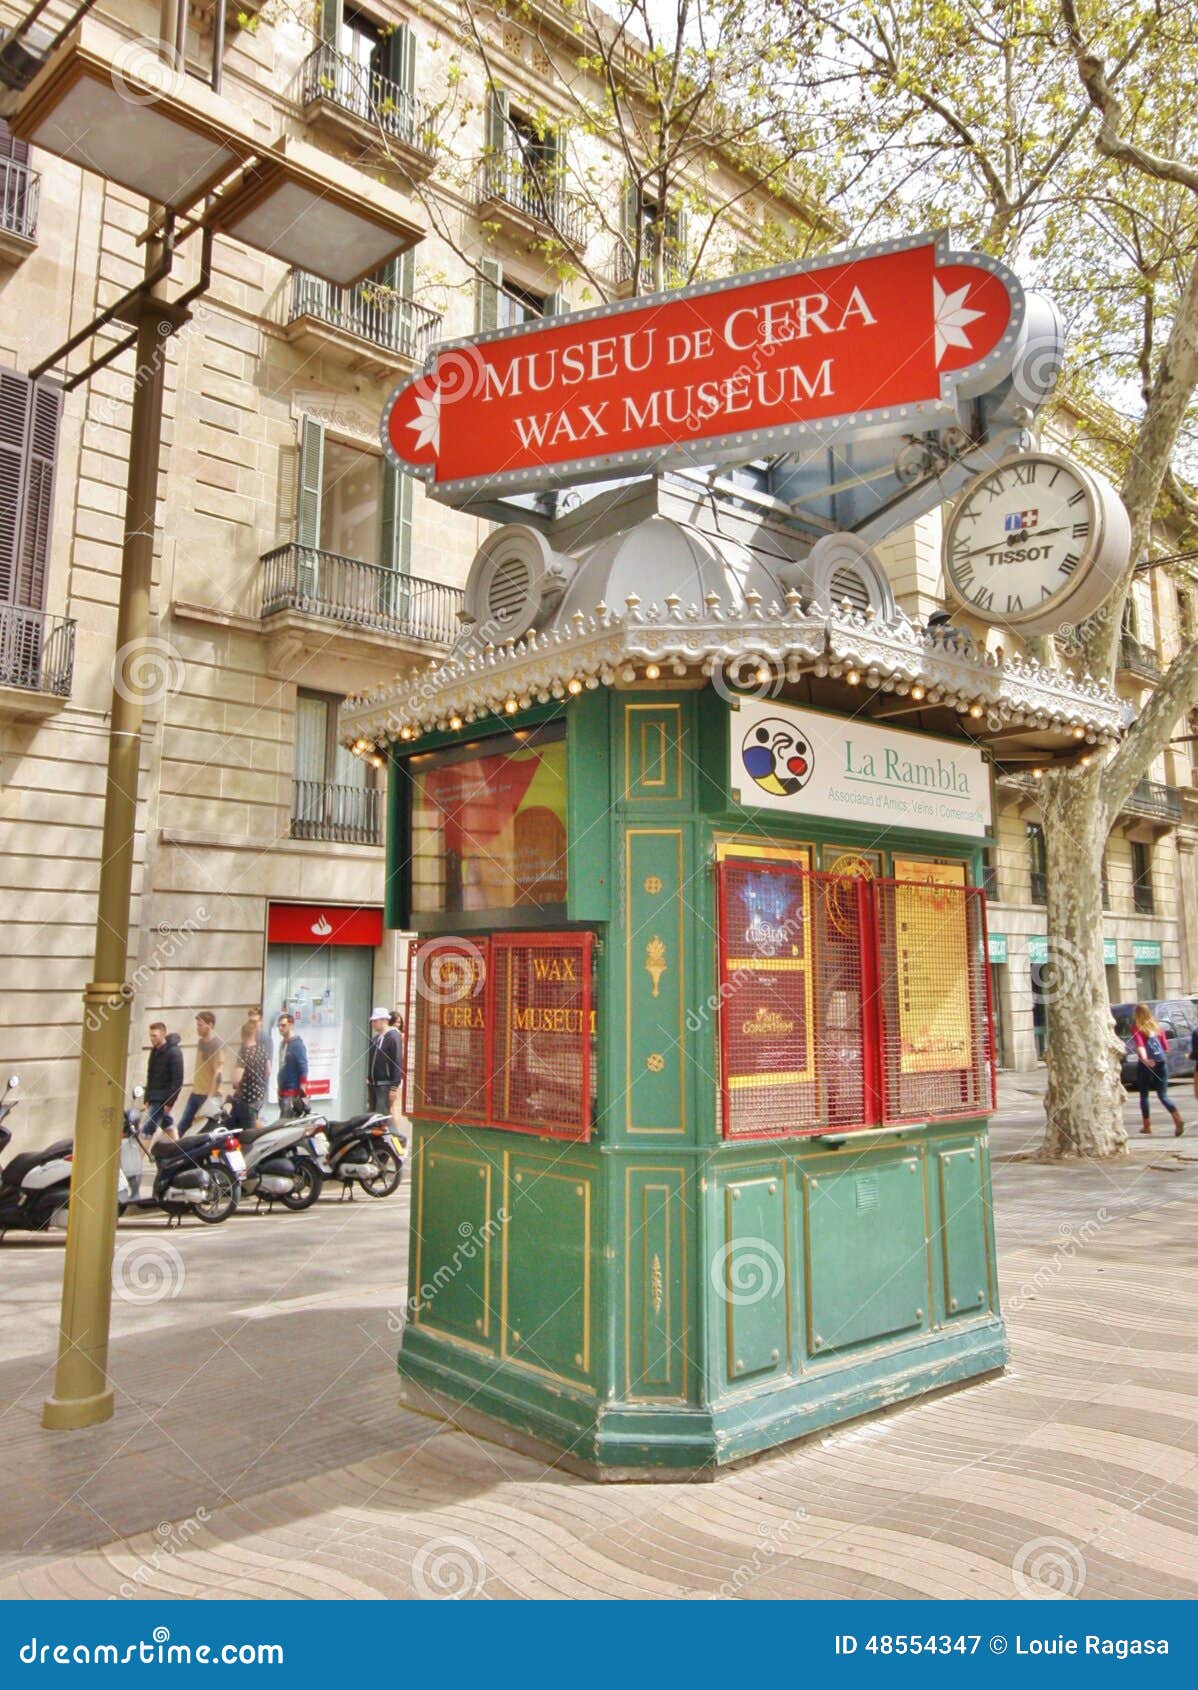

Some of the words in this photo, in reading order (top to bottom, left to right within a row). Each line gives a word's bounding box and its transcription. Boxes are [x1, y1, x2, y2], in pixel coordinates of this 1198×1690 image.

[482, 329, 656, 402] MUSEU
[667, 327, 714, 365] DE
[723, 286, 877, 351] CERA
[513, 401, 609, 449] WAX
[622, 359, 835, 432] MUSEUM
[986, 545, 1054, 566] TISSOT
[844, 740, 876, 777] La
[884, 747, 970, 793] Rambla
[533, 958, 577, 981] WAX
[443, 1007, 485, 1029] CERA
